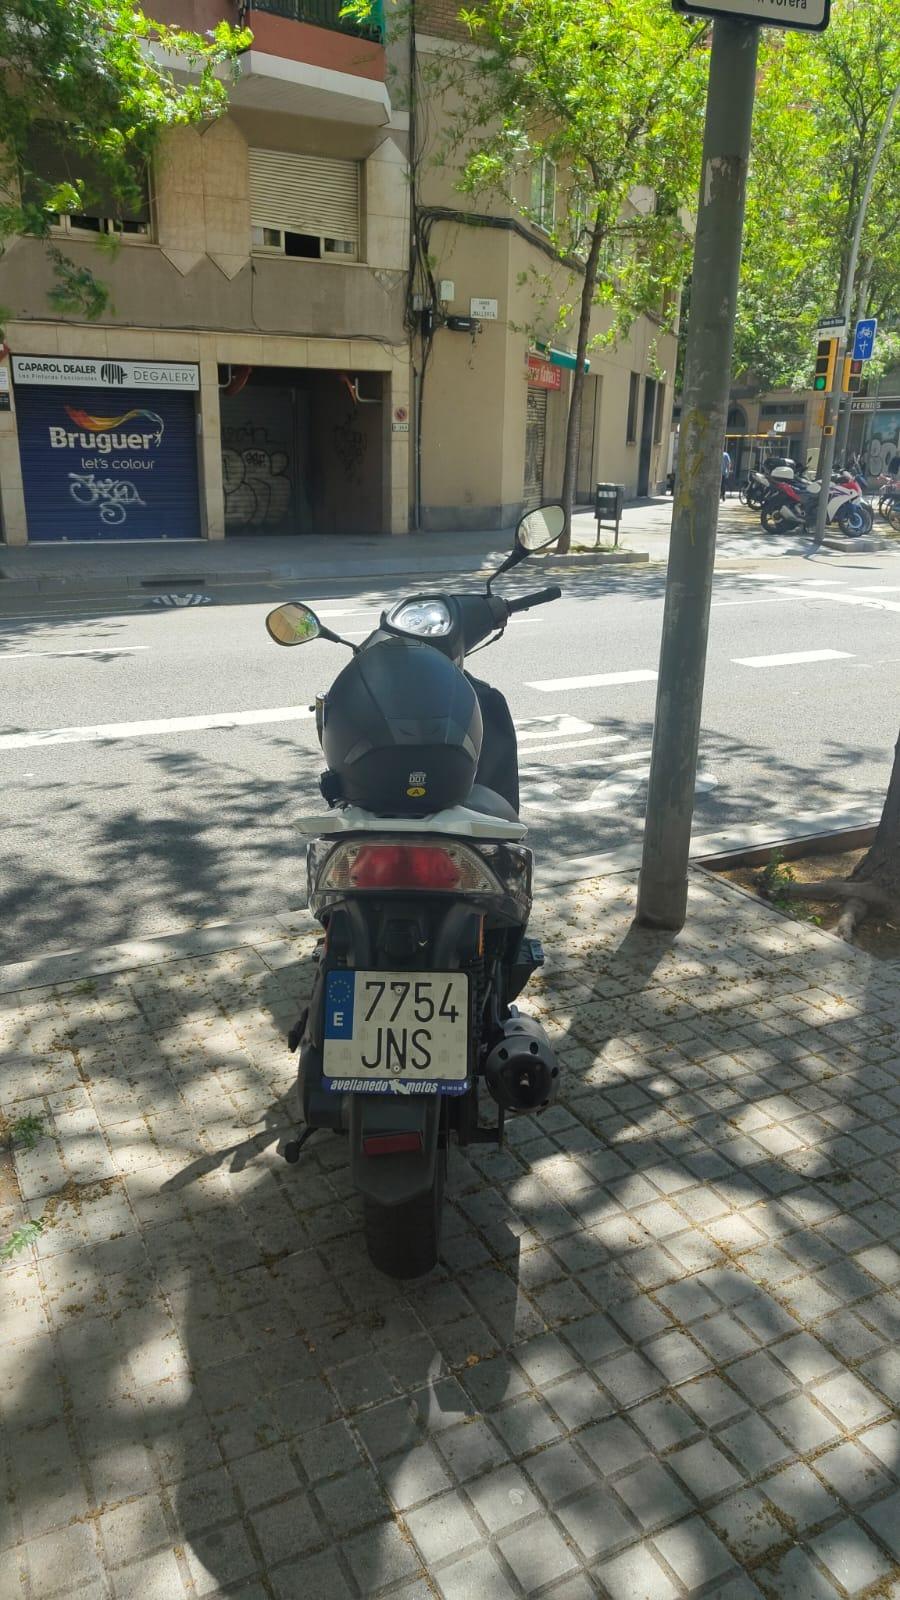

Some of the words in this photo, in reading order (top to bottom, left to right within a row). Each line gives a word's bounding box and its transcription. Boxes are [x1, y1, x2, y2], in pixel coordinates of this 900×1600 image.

[18, 362, 62, 373] CAPAROL
[63, 364, 96, 374] DEALER
[133, 370, 196, 383] DEGALERY
[49, 426, 154, 454] Bruguer
[81, 458, 109, 470] let's
[112, 458, 156, 470] colour
[364, 981, 459, 1023] 7754
[333, 1011, 344, 1027] E
[361, 1028, 432, 1070] JNS
[330, 1079, 388, 1092] avellanedo
[405, 1081, 439, 1093] motos
